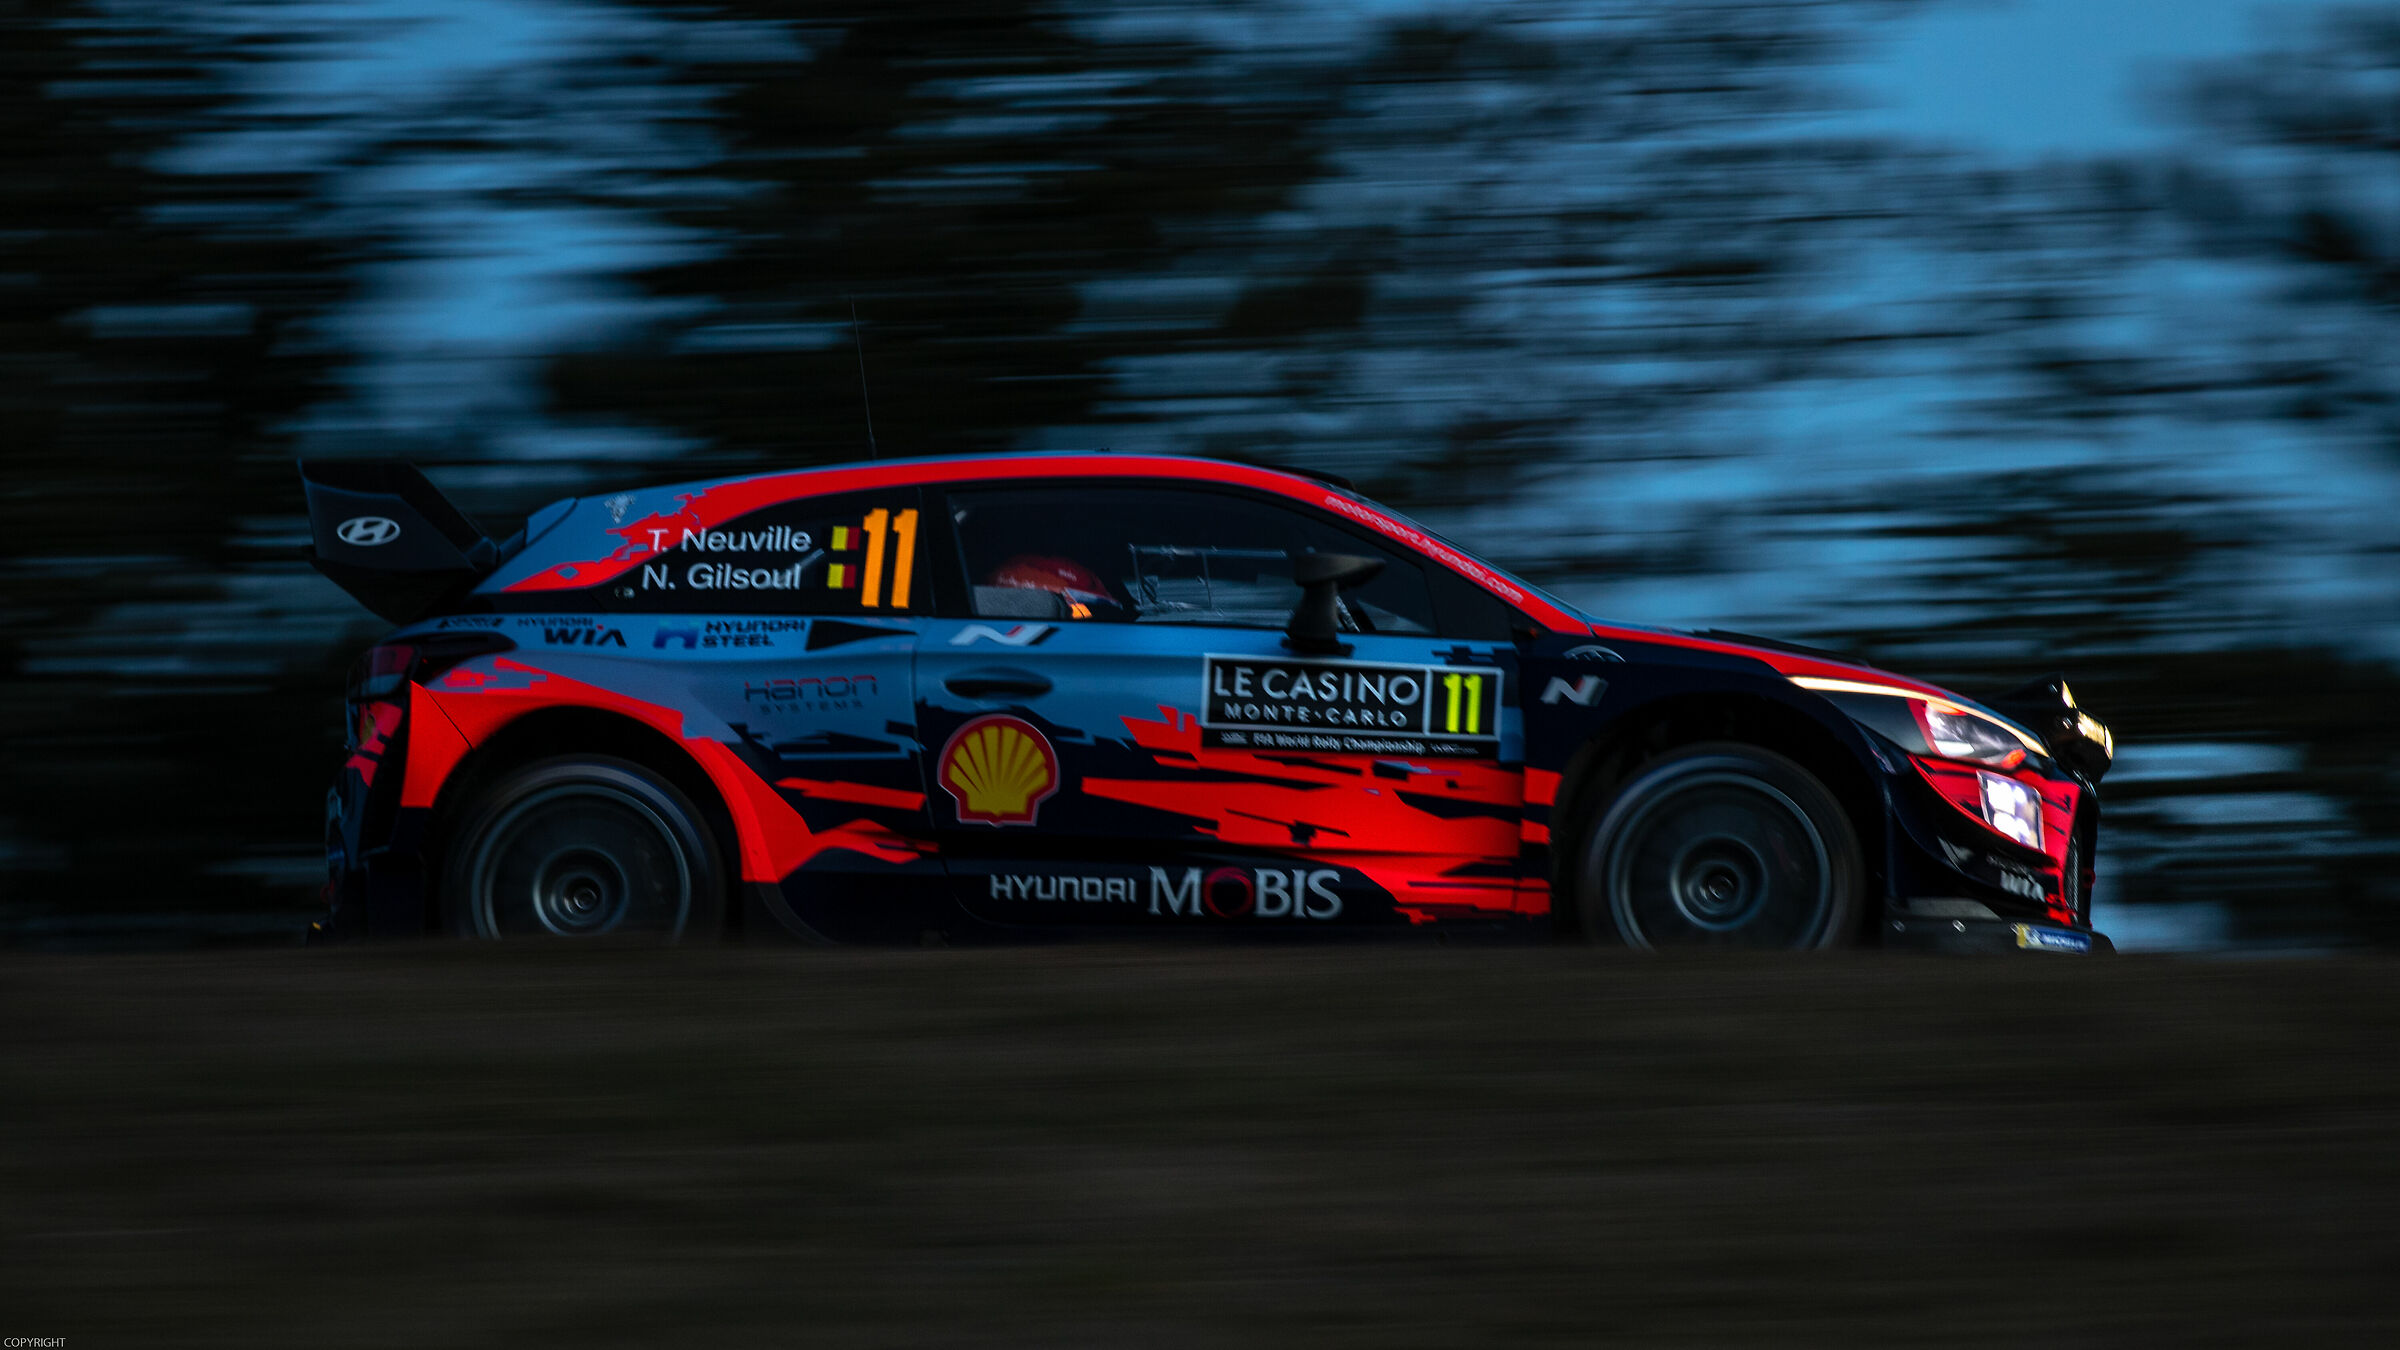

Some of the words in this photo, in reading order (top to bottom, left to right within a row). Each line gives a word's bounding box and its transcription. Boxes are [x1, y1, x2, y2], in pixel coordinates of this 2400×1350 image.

[647, 528, 669, 553] T.
[681, 525, 812, 552] Neuville
[861, 507, 919, 609] 11
[641, 563, 676, 591] N.
[686, 562, 801, 591] Gilsoul
[703, 633, 774, 648] STEEL
[705, 620, 806, 633] HYUNDAI
[1213, 665, 1255, 698] LE
[1261, 667, 1421, 706] CASINO
[759, 699, 866, 715] SYSTEMS
[1443, 673, 1483, 734] 11
[1276, 733, 1311, 748] World
[1311, 735, 1343, 752] Rally
[989, 874, 1138, 903] HYUNDAI
[1148, 865, 1344, 919] MOBIS
